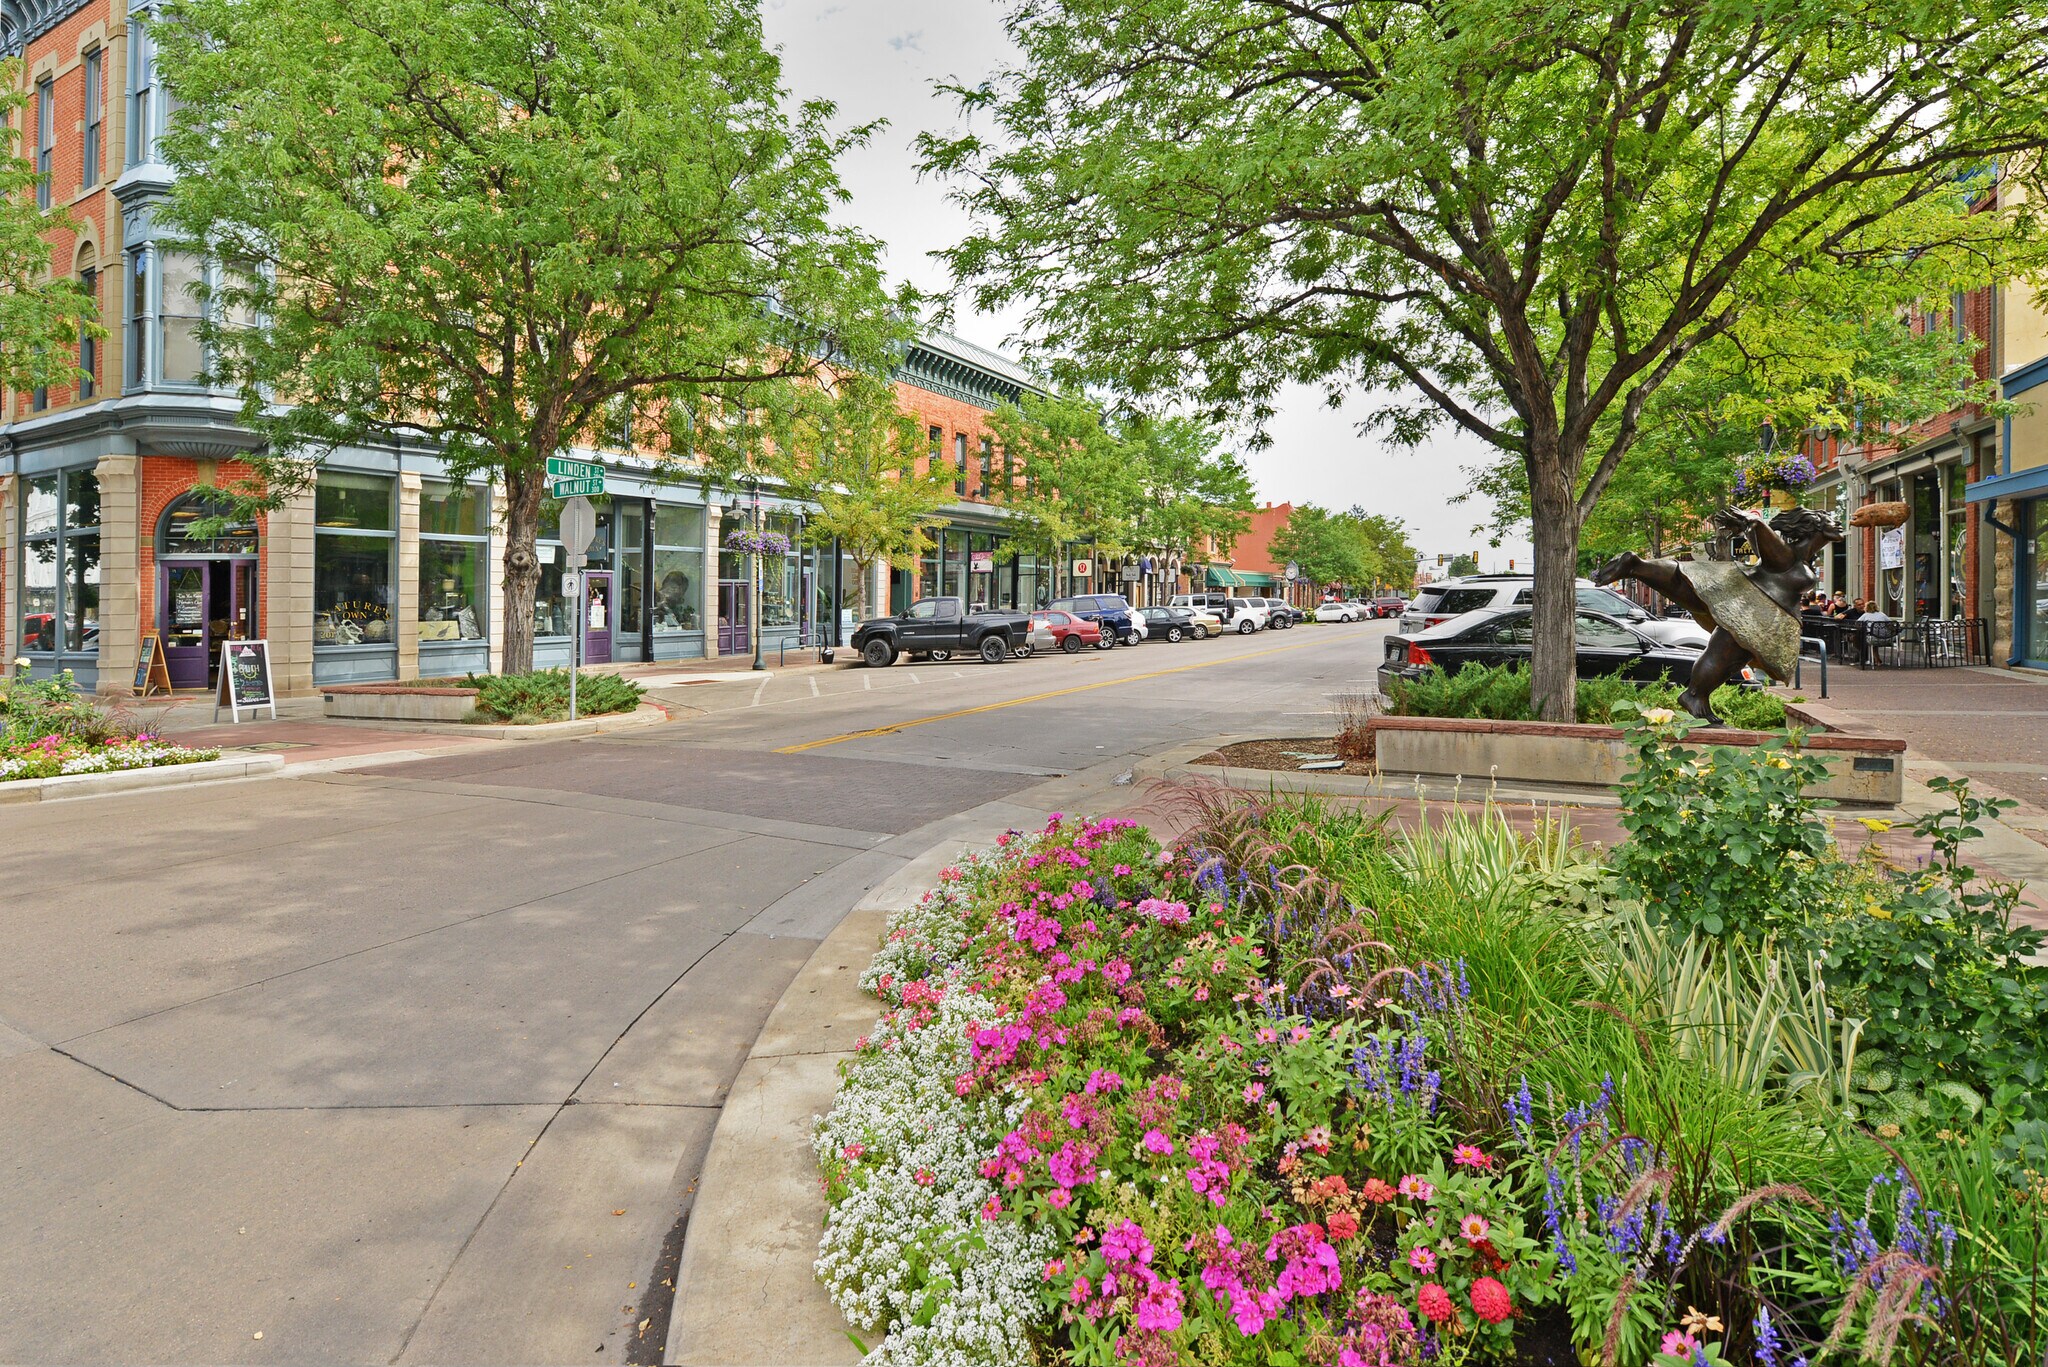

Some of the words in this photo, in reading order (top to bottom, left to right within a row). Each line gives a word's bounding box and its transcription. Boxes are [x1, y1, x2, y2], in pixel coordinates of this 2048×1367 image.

[558, 461, 591, 478] LINDEN
[559, 480, 591, 495] WALNUT
[342, 611, 367, 619] OWN
